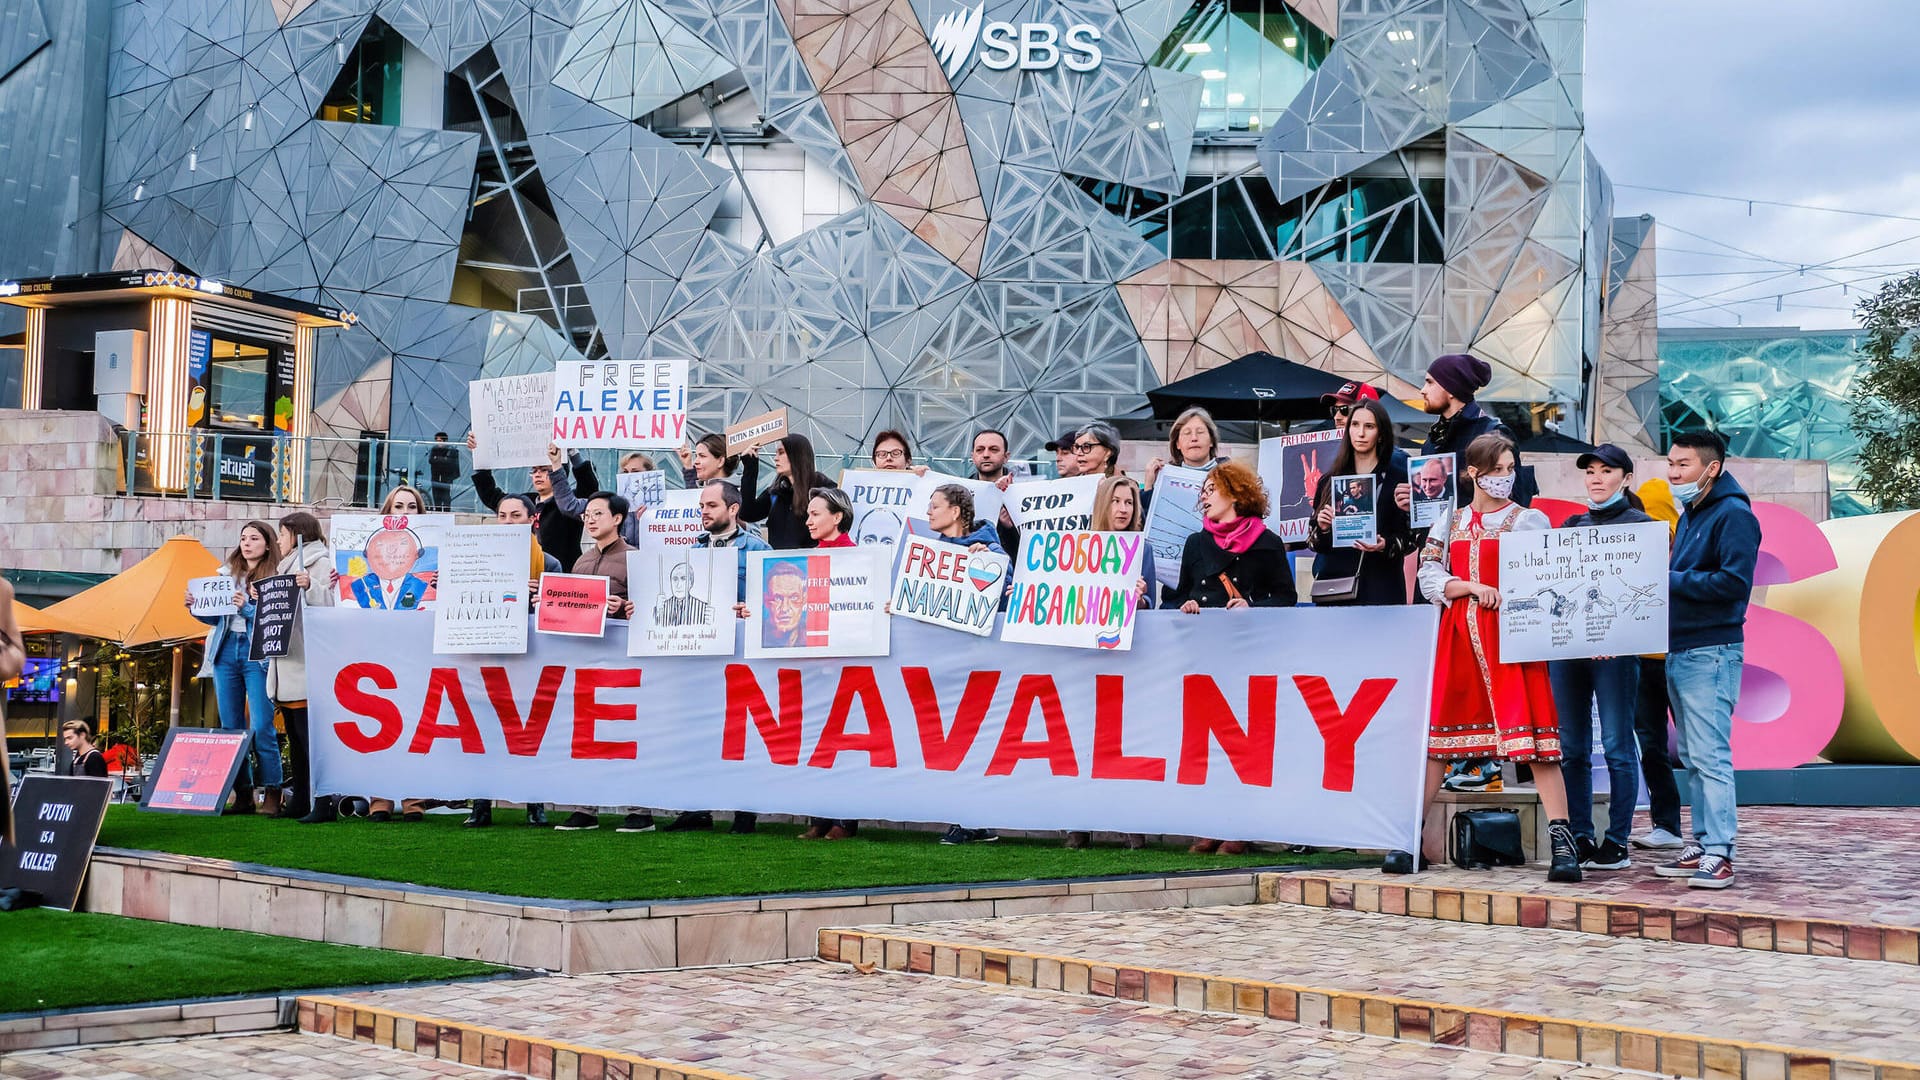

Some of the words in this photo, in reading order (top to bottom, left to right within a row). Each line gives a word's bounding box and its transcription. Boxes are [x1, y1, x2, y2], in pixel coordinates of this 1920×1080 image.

[980, 21, 1102, 72] SBS
[579, 363, 671, 387] FREE
[553, 414, 685, 440] NAVALNY
[730, 432, 748, 444] PUTIN
[760, 419, 783, 432] KILLER
[1281, 432, 1317, 447] FREEDOM
[221, 458, 255, 480] atiyah
[1021, 493, 1074, 513] STOP
[656, 509, 680, 519] FREE
[682, 508, 702, 518] RUS
[648, 524, 666, 532] FREE
[668, 524, 682, 532] ALL
[684, 523, 702, 531] POLI
[1543, 534, 1548, 548] I
[1558, 531, 1582, 548] left
[1588, 528, 1635, 545] Russia
[905, 543, 969, 583] FREE
[1027, 534, 1140, 576] СВОБОДУ
[1508, 560, 1520, 569] so
[1524, 551, 1550, 567] that
[1557, 557, 1571, 570] my
[1579, 549, 1598, 562] tax
[1604, 551, 1642, 565] money
[1536, 566, 1585, 581] wouldn't
[1591, 569, 1604, 580] go
[1610, 564, 1622, 575] to
[203, 580, 231, 592] FREE
[546, 589, 588, 599] Opposition
[194, 596, 233, 609] NAVAL
[461, 591, 494, 604] FREE
[558, 601, 598, 609] extremism
[896, 578, 1000, 629] NAVALNY
[1007, 582, 1138, 628] НАВАЛЬНОМУ
[446, 607, 511, 620] NAVALNY
[698, 629, 717, 639] should
[333, 662, 643, 760] SAVE
[720, 664, 1398, 793] NAVALNY
[38, 803, 74, 822] PUTIN
[40, 831, 49, 843] IS
[49, 831, 55, 844] A
[20, 851, 58, 872] KILLER
